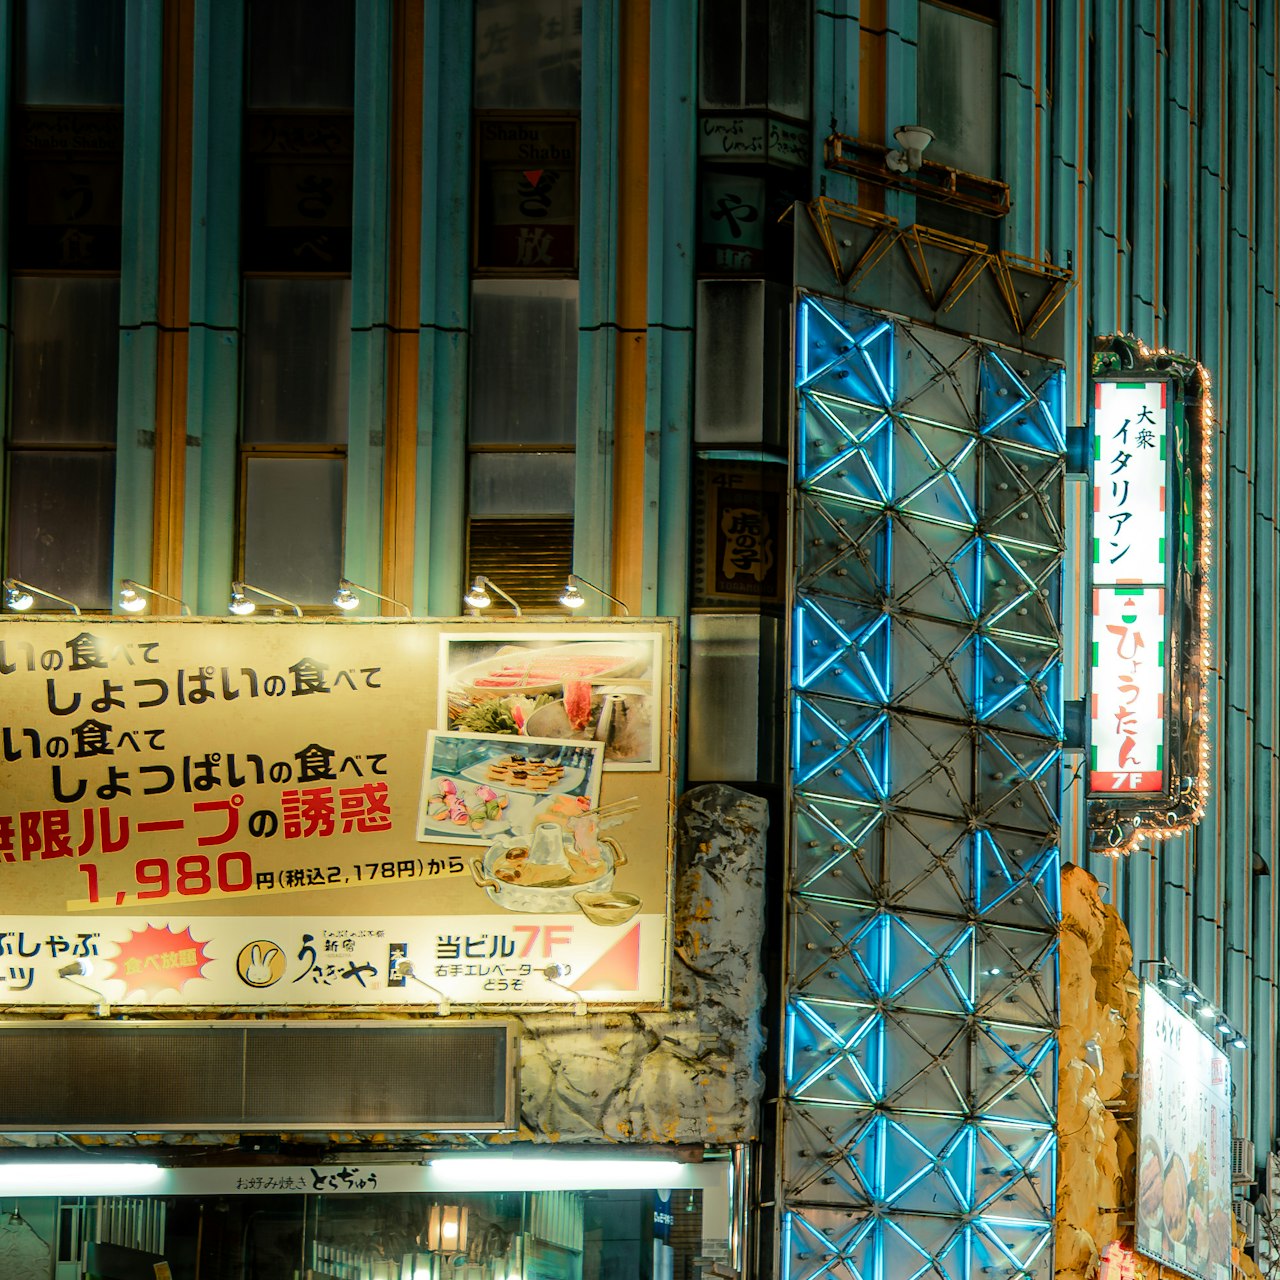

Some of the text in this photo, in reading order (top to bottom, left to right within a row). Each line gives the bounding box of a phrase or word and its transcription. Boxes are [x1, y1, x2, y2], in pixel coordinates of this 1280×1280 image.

[486, 124, 539, 141] Shabu
[518, 143, 572, 160] Shabu
[1137, 405, 1155, 449] 大衆
[712, 473, 744, 489] 4F
[1109, 418, 1132, 566] イタリアン
[1107, 624, 1147, 769] ひょうたん
[1111, 773, 1143, 790] 7F
[324, 939, 356, 953] 新宿
[436, 924, 575, 960] 当ビル7F
[124, 948, 198, 976] 食べ放題
[483, 978, 525, 992] どうぞ
[236, 1176, 307, 1190] お好み焼き
